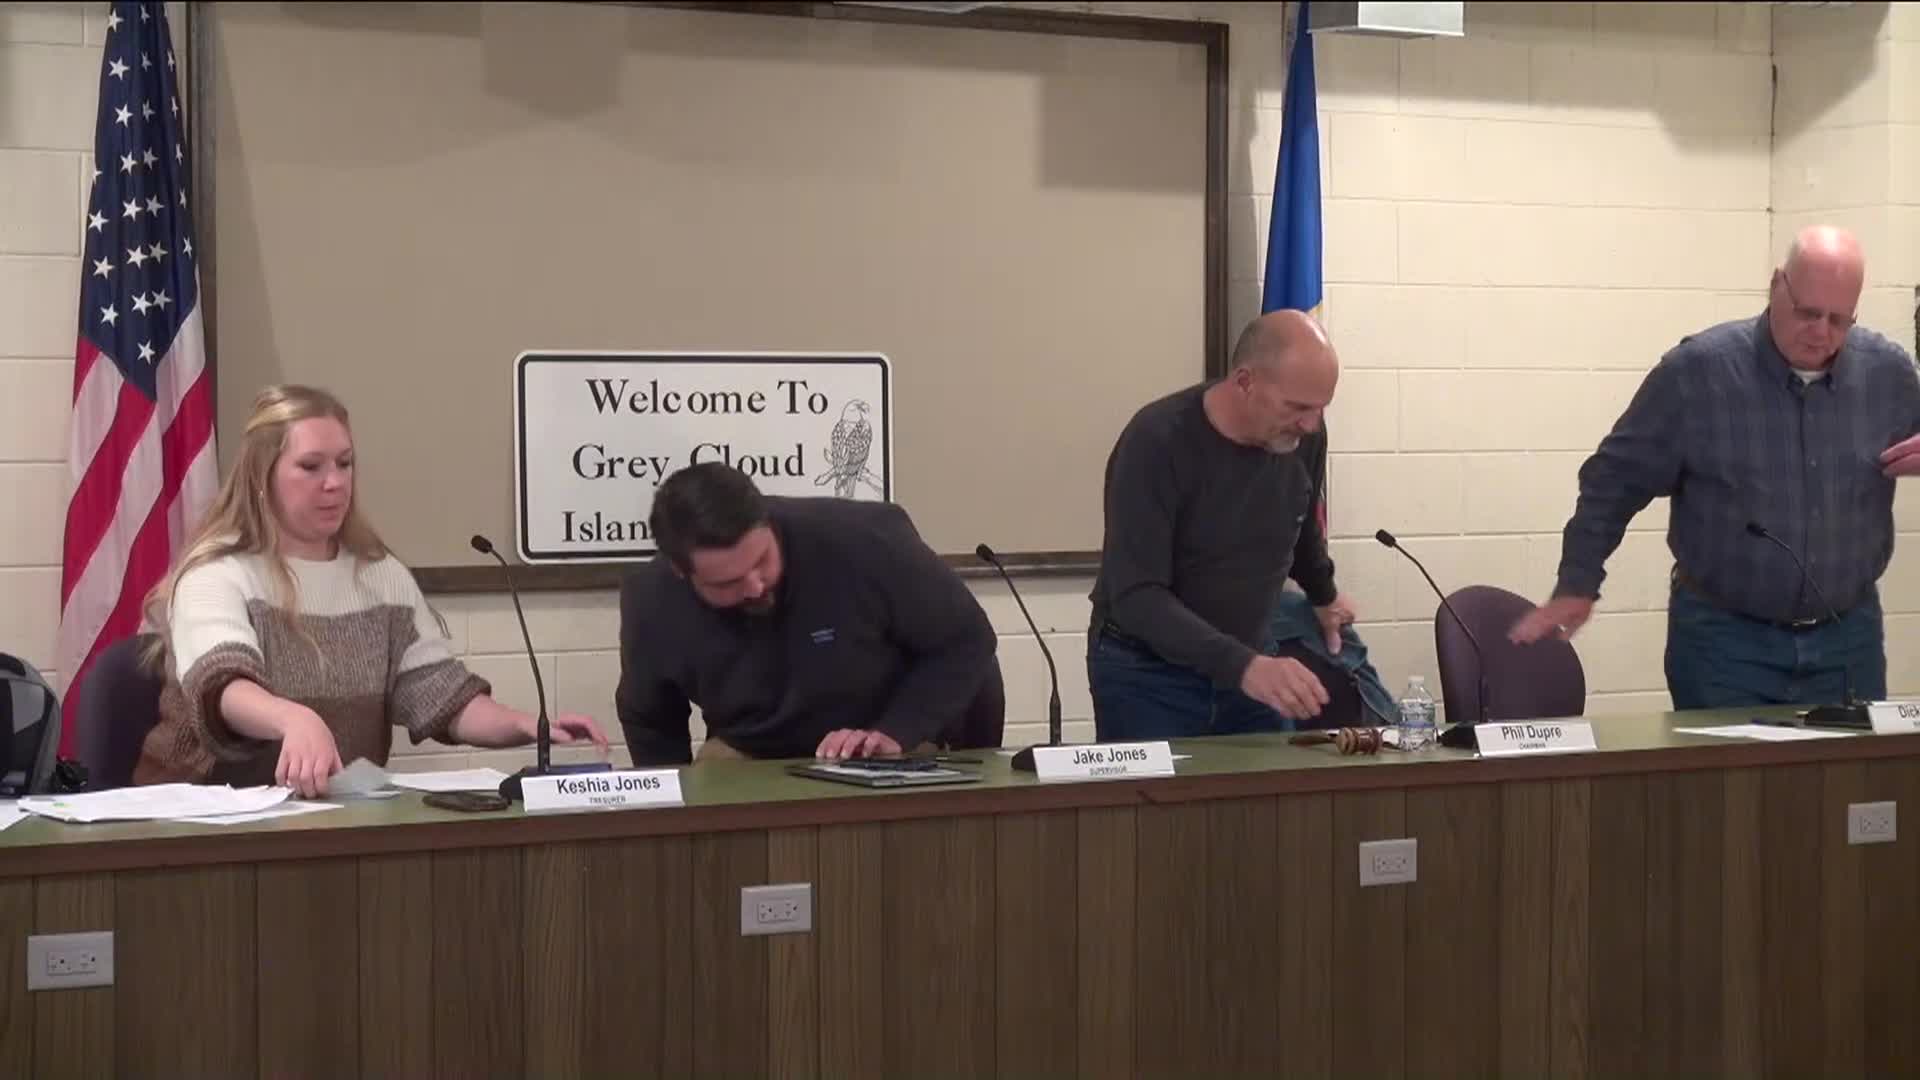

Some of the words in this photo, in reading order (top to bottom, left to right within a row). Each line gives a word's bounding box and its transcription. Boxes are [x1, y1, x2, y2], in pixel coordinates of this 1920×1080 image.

[585, 378, 767, 415] Welcome
[777, 379, 829, 415] To
[572, 443, 671, 486] Grey
[689, 442, 806, 478] Cloud
[561, 510, 653, 542] Islan
[1501, 725, 1525, 740] Phil
[1527, 724, 1562, 741] Dupre
[1073, 749, 1104, 765] Jake
[1107, 747, 1148, 763] Jones
[556, 776, 610, 795] Keshia
[615, 775, 661, 792] Jones
